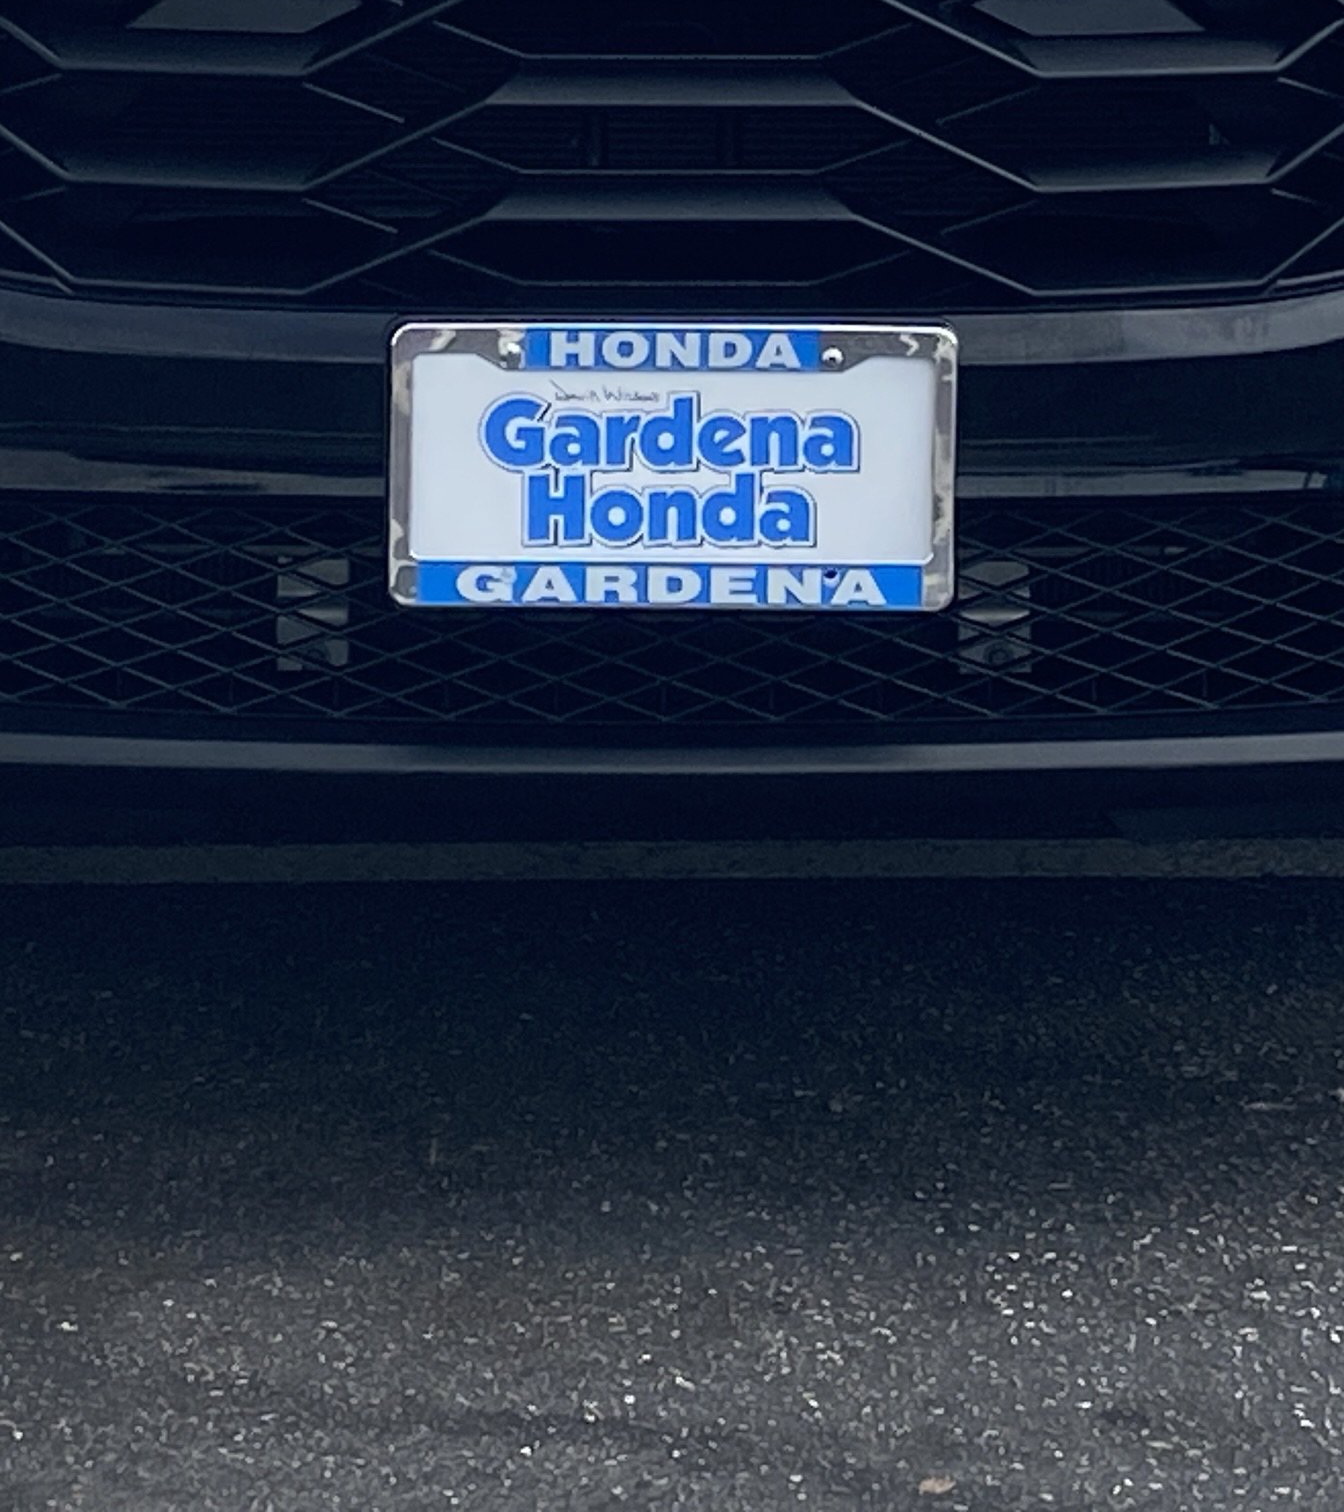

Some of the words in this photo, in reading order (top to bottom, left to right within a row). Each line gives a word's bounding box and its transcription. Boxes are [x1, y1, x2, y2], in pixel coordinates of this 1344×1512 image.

[549, 331, 801, 370] HONDA
[484, 394, 856, 468] Gardena
[525, 470, 813, 544] Honda
[456, 567, 887, 604] GARDENA
